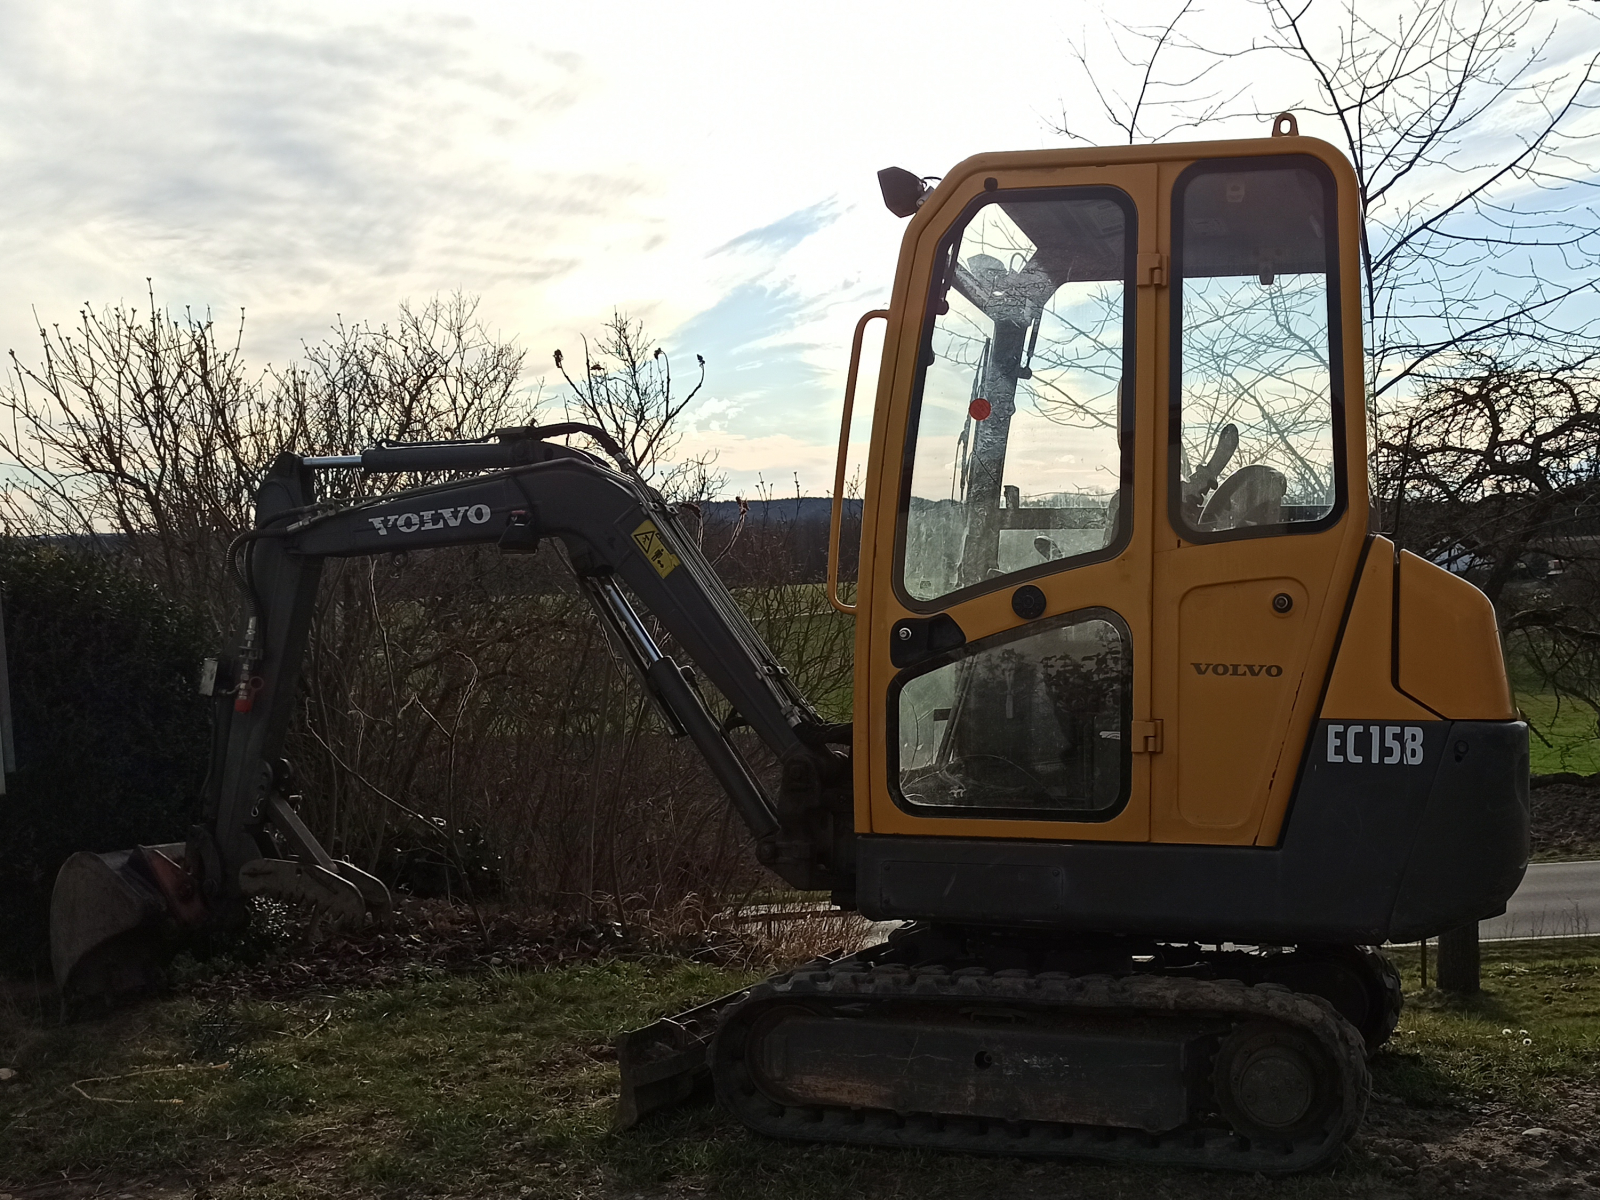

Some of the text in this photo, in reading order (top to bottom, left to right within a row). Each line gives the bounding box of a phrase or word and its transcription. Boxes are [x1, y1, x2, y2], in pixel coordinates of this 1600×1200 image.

[368, 504, 491, 536] VOLVO
[1190, 663, 1283, 677] VOLVO
[1327, 725, 1424, 765] EC15B
